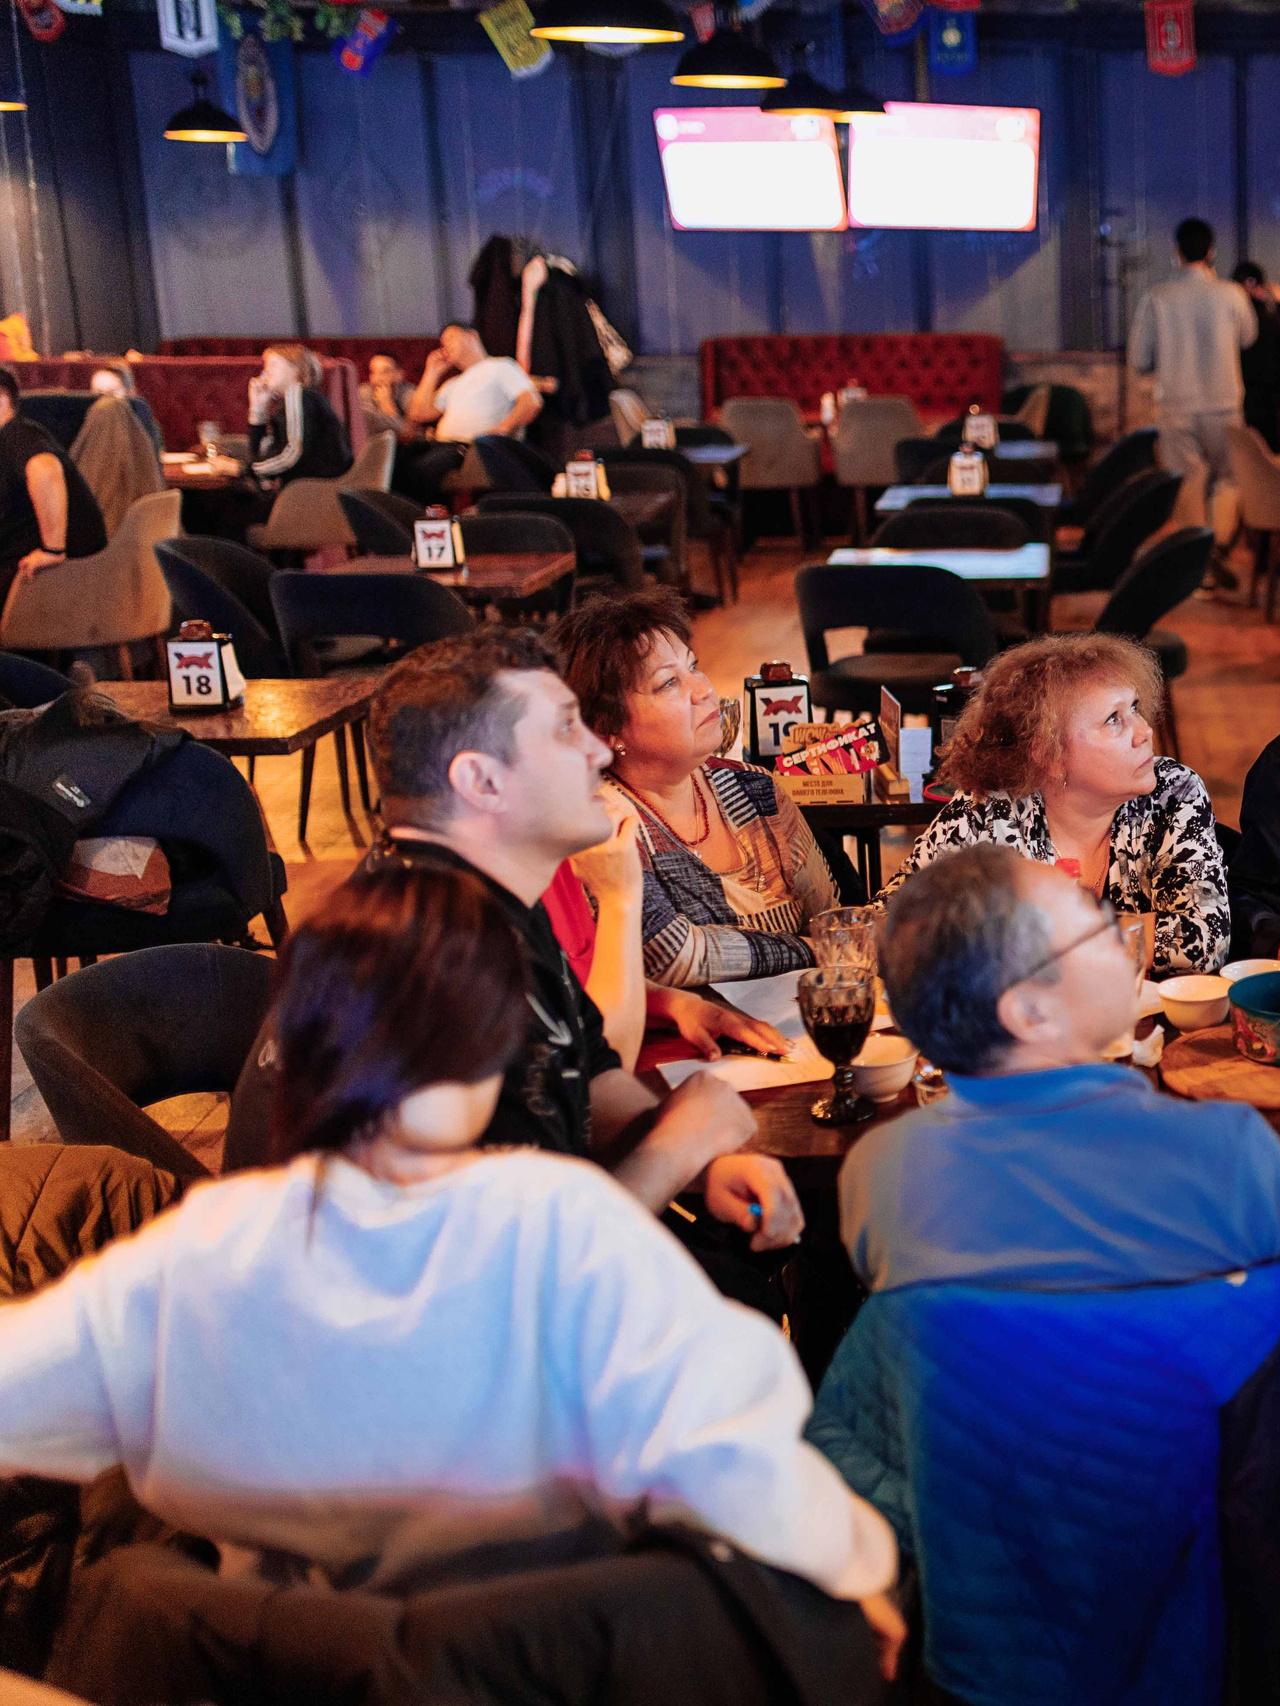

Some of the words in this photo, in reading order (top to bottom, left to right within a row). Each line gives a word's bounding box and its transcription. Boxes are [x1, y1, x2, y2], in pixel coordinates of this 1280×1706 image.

[426, 545, 446, 558] 17
[182, 675, 212, 695] 18
[782, 722, 876, 769] СЕРТИФИКАТ
